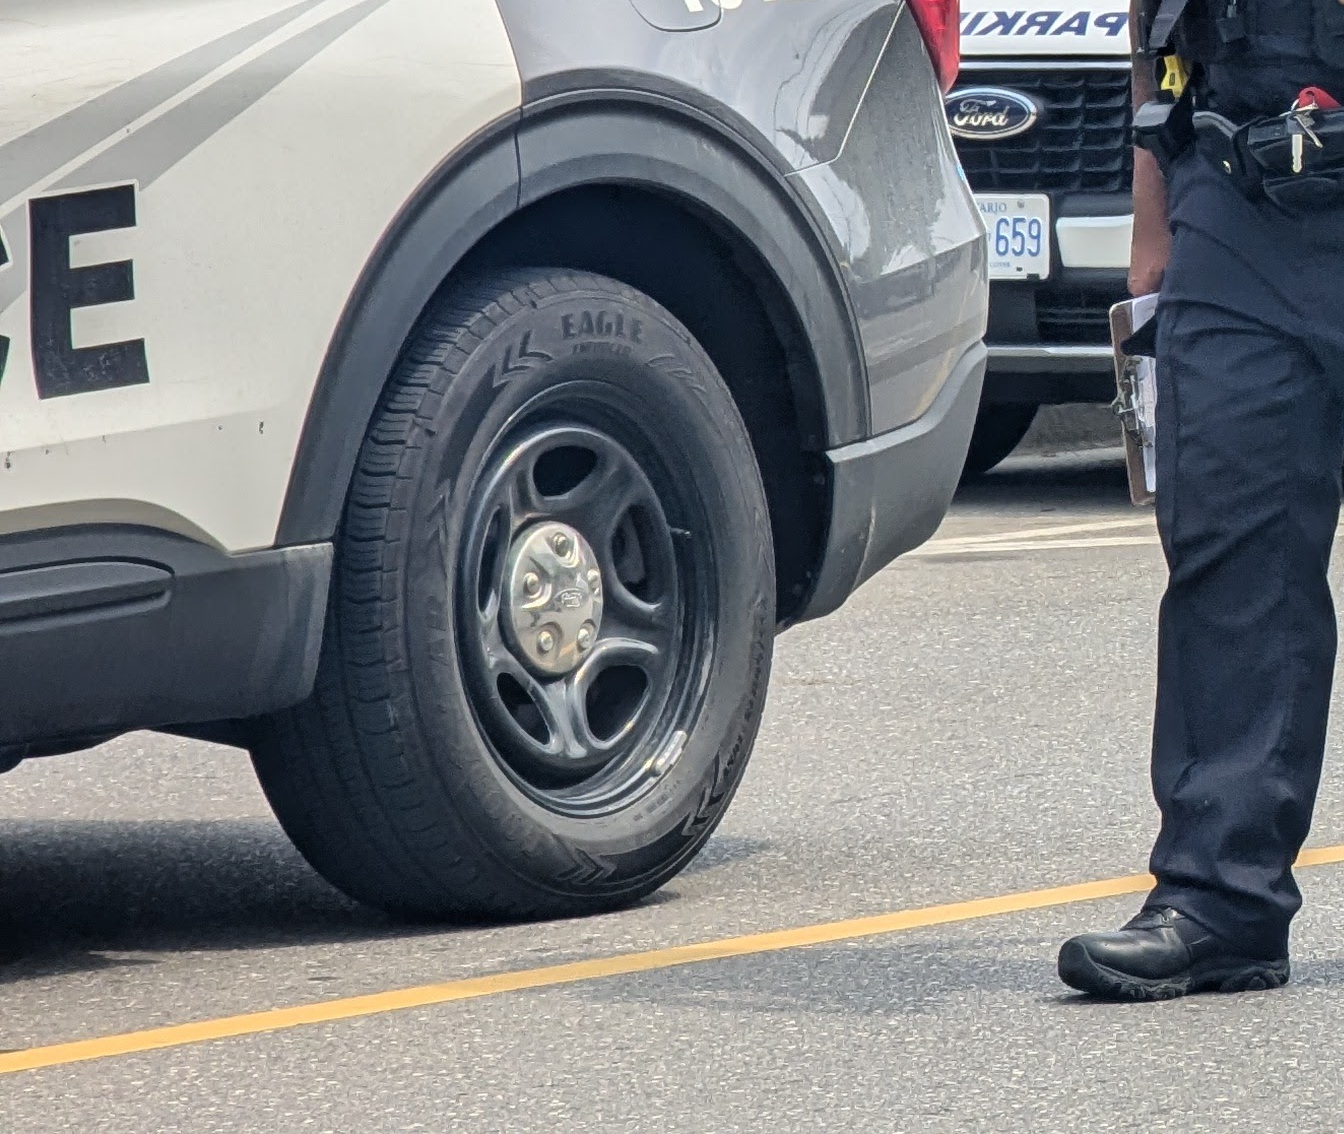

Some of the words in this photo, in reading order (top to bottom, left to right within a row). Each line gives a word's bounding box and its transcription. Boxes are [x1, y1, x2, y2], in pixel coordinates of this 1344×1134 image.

[953, 98, 1010, 127] Ford
[979, 202, 1007, 213] ARIO
[995, 217, 1042, 257] 659
[561, 310, 643, 344] EAGLE
